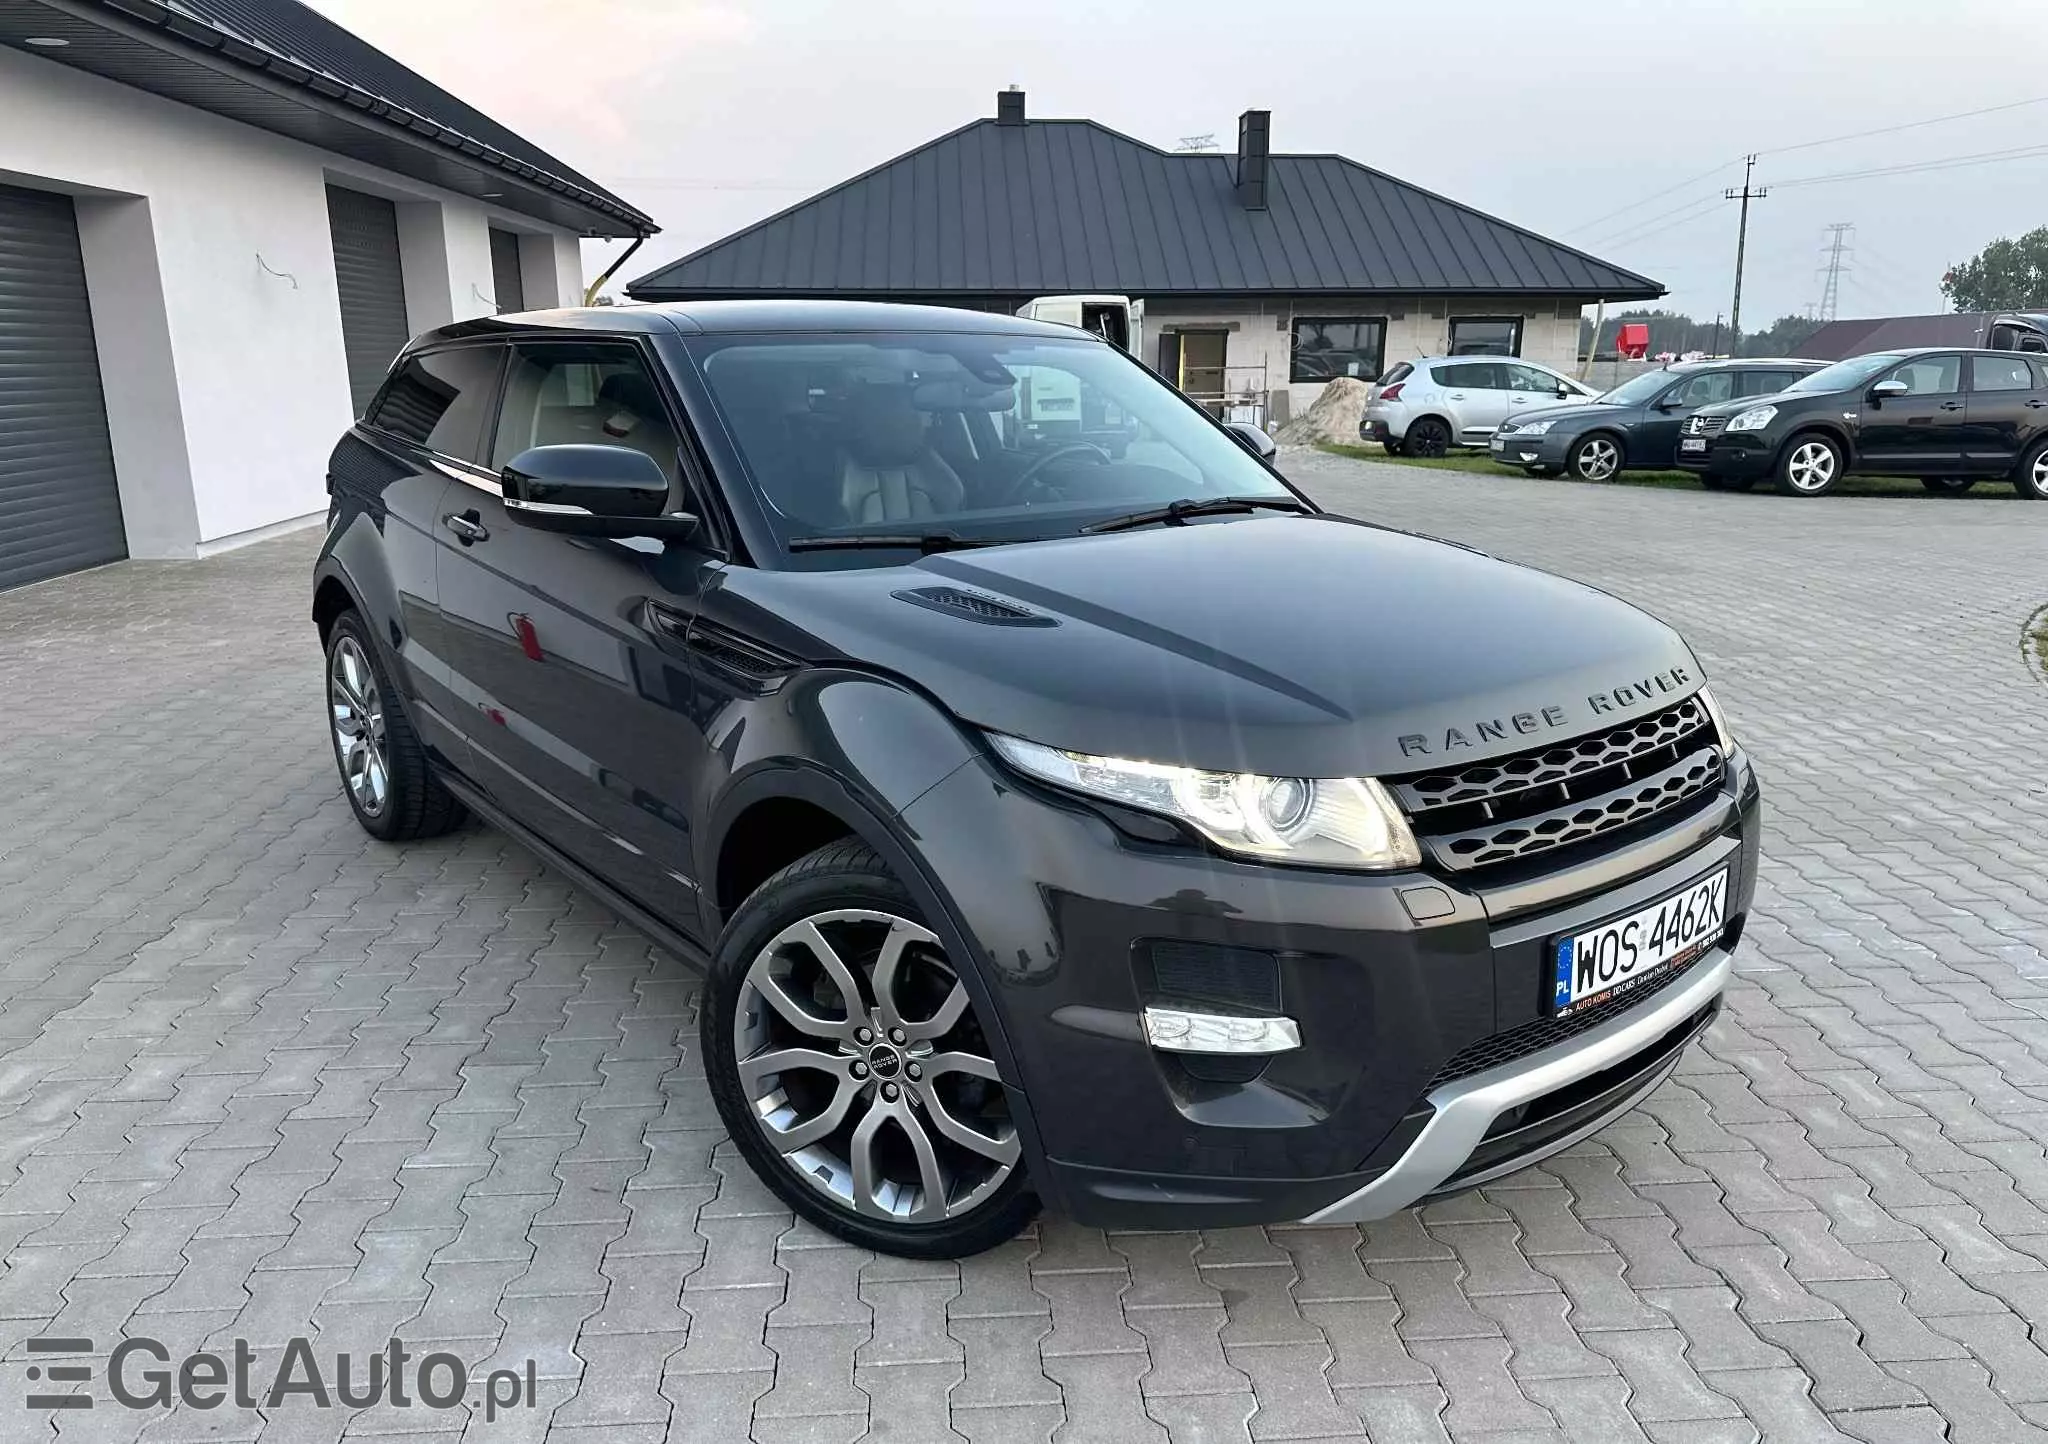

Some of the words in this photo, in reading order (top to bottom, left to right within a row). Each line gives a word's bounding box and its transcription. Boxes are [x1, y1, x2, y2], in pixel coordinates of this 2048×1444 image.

[1398, 705, 1569, 757] RANGE
[1587, 667, 1691, 714] ROVER
[1577, 920, 1640, 994] WOS
[1649, 874, 1724, 957] 4462K
[1556, 980, 1570, 998] PL
[1575, 997, 1593, 1012] AUTO
